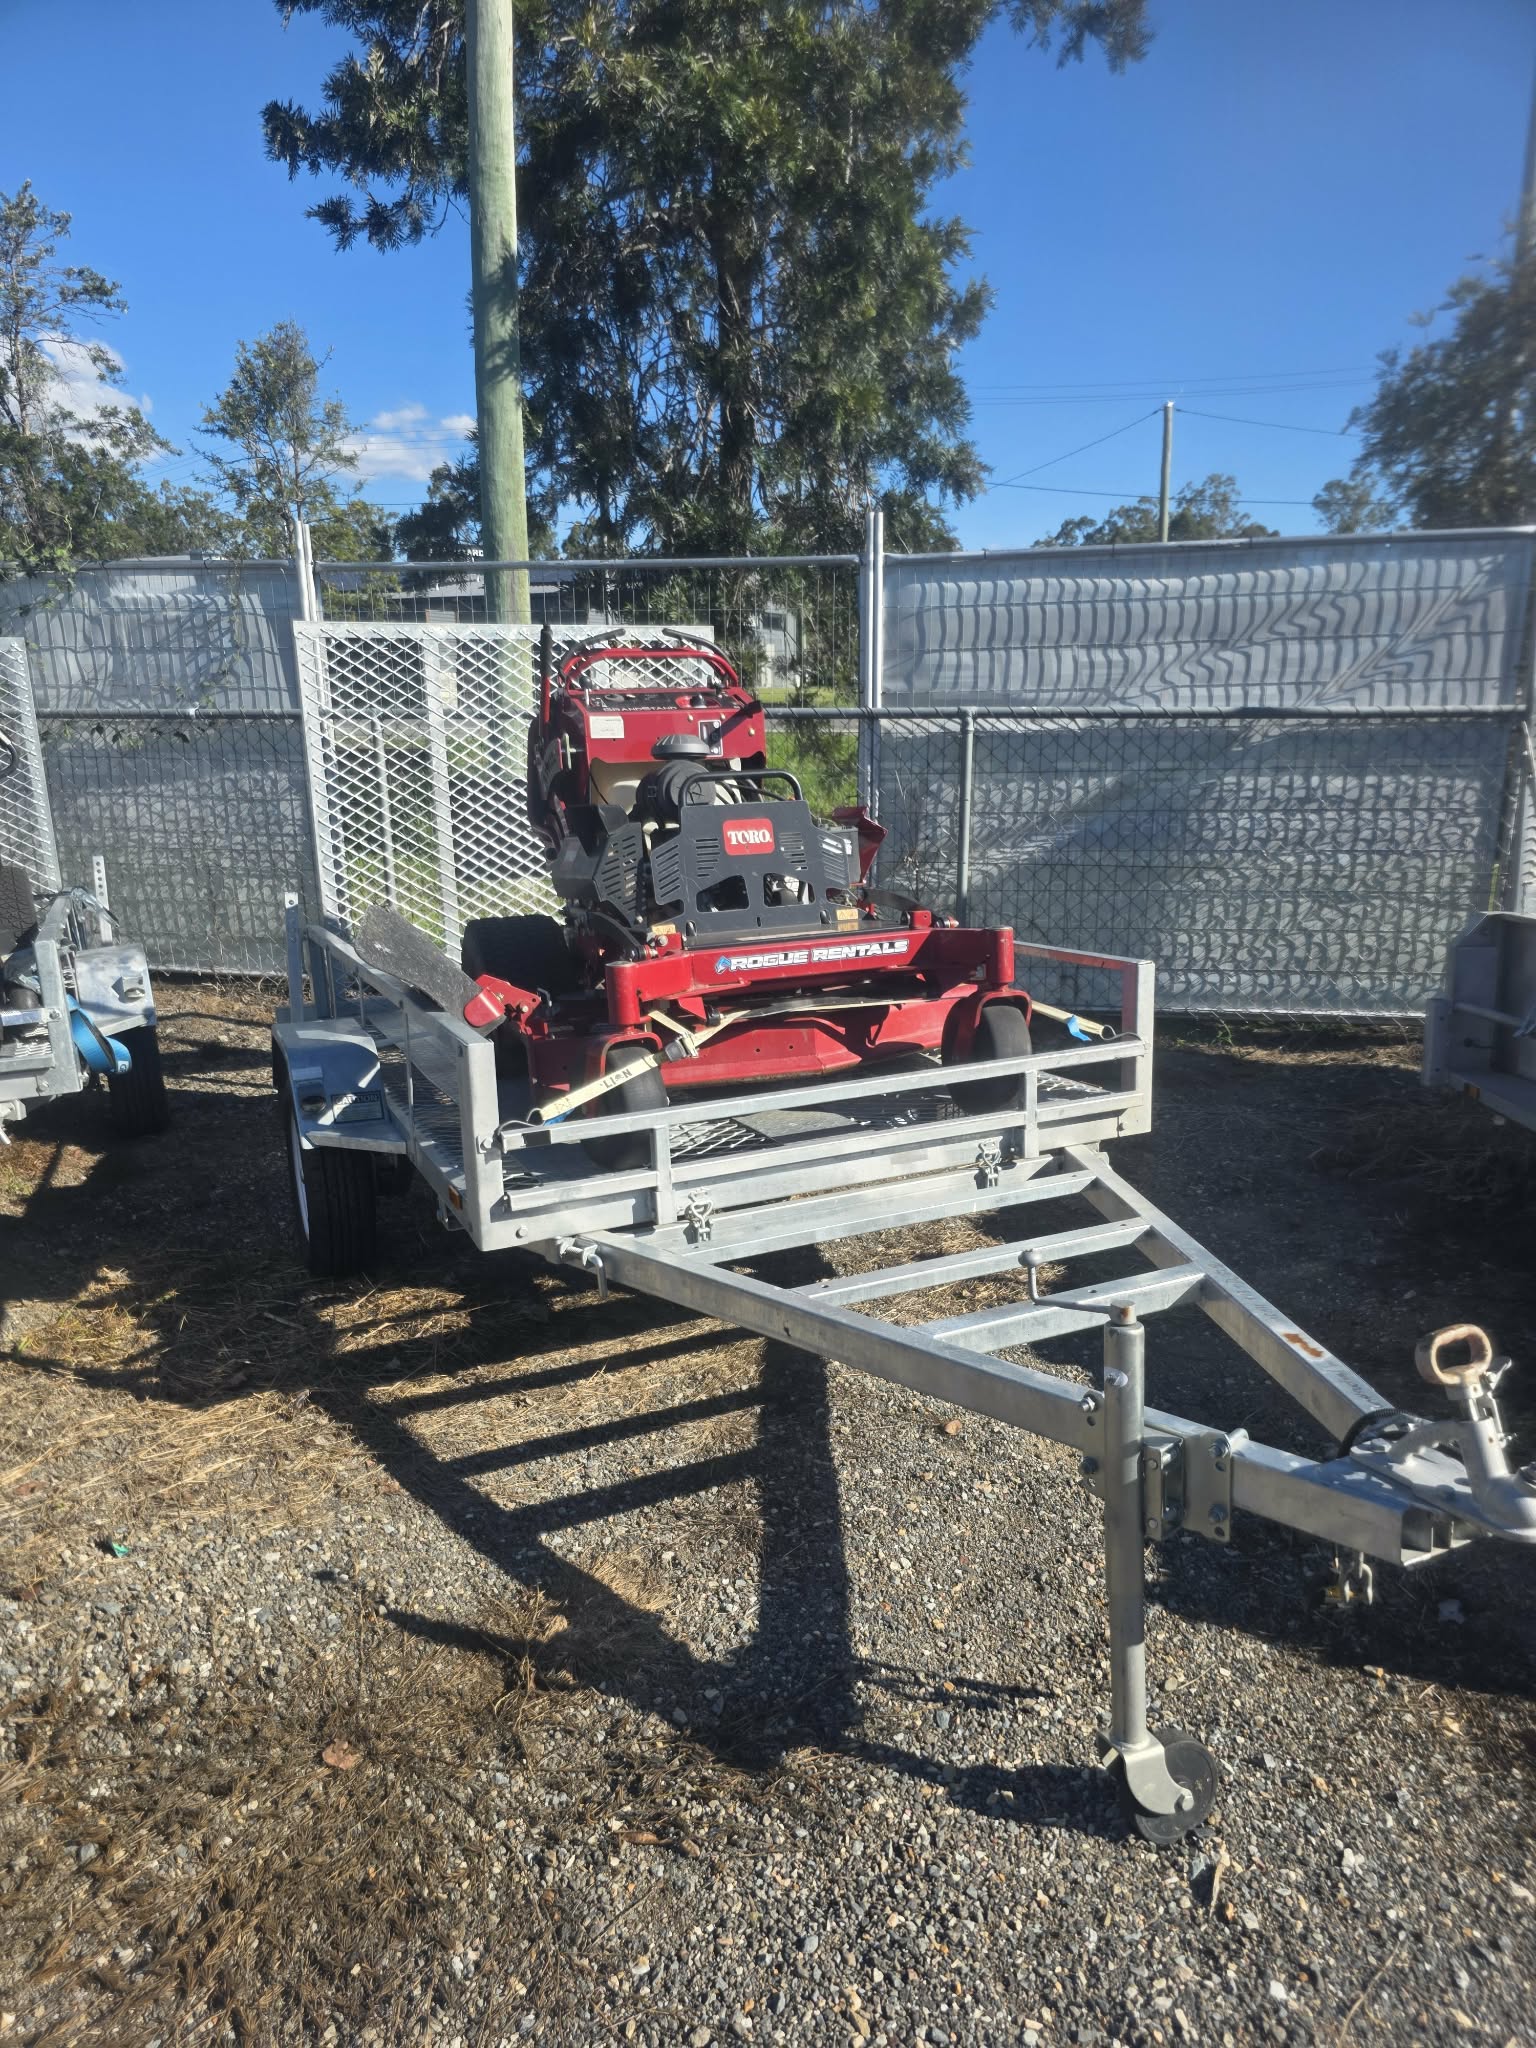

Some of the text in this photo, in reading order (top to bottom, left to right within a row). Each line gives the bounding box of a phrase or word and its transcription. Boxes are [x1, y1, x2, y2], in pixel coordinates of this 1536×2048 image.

[727, 829, 772, 845] TORO
[730, 940, 909, 971] ROGUE RENTALS
